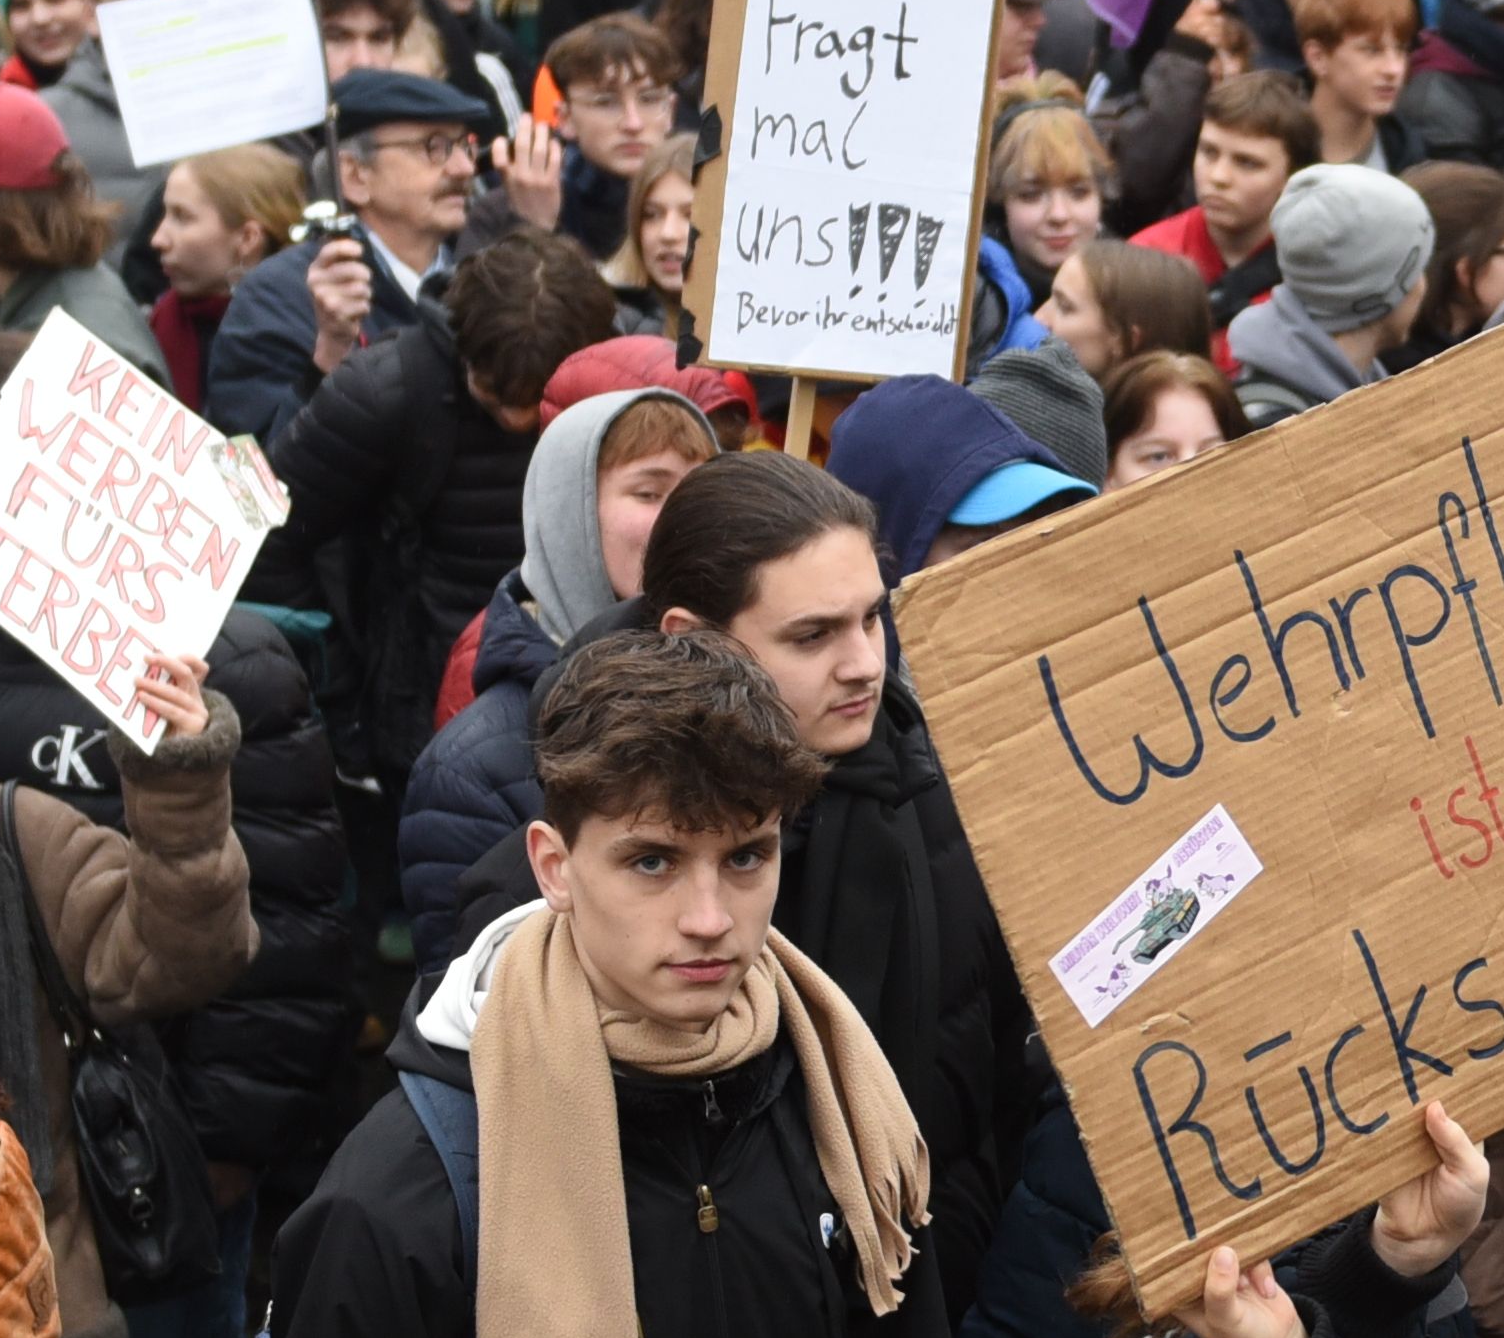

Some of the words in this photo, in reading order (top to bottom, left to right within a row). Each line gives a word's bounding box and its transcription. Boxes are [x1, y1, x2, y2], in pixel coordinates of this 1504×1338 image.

[751, 100, 868, 170] mal
[736, 290, 812, 334] Bevor
[814, 294, 850, 328] ihr
[67, 340, 210, 477] KEIN
[5, 463, 183, 624] FÜRS
[17, 377, 242, 592] WERBEN
